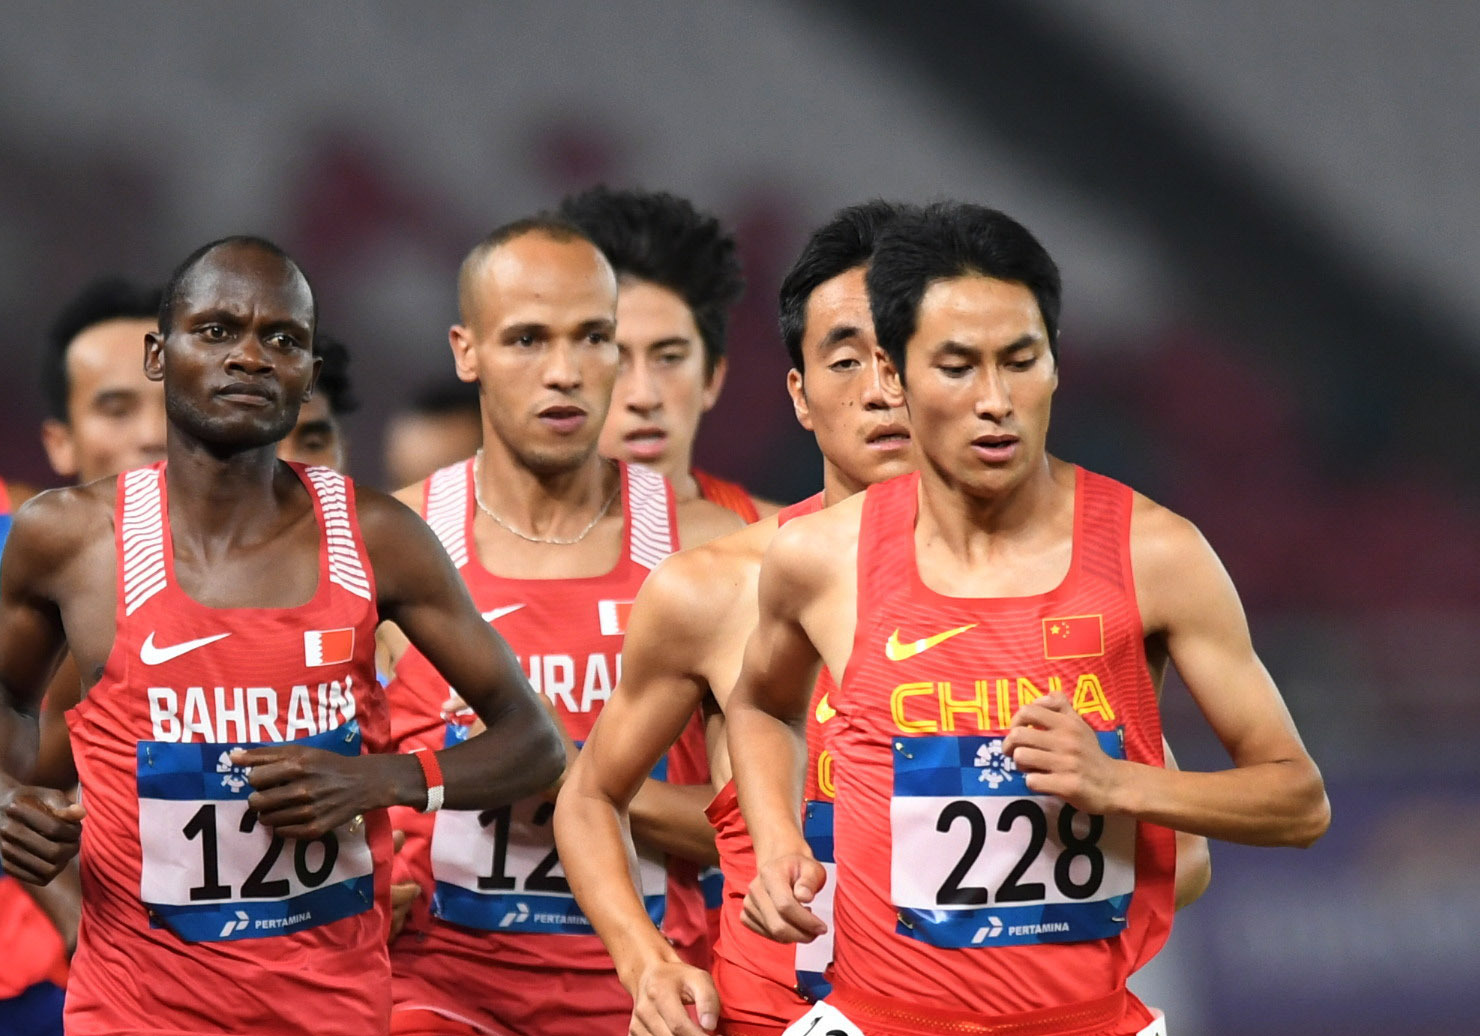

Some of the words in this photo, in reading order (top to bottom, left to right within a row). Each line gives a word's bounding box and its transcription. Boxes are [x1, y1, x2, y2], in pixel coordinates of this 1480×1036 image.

[147, 674, 357, 743] BAHRAIN
[935, 798, 1106, 905] 228
[254, 910, 312, 930] PERTAMINA
[1007, 921, 1070, 937] PERTAMINA
